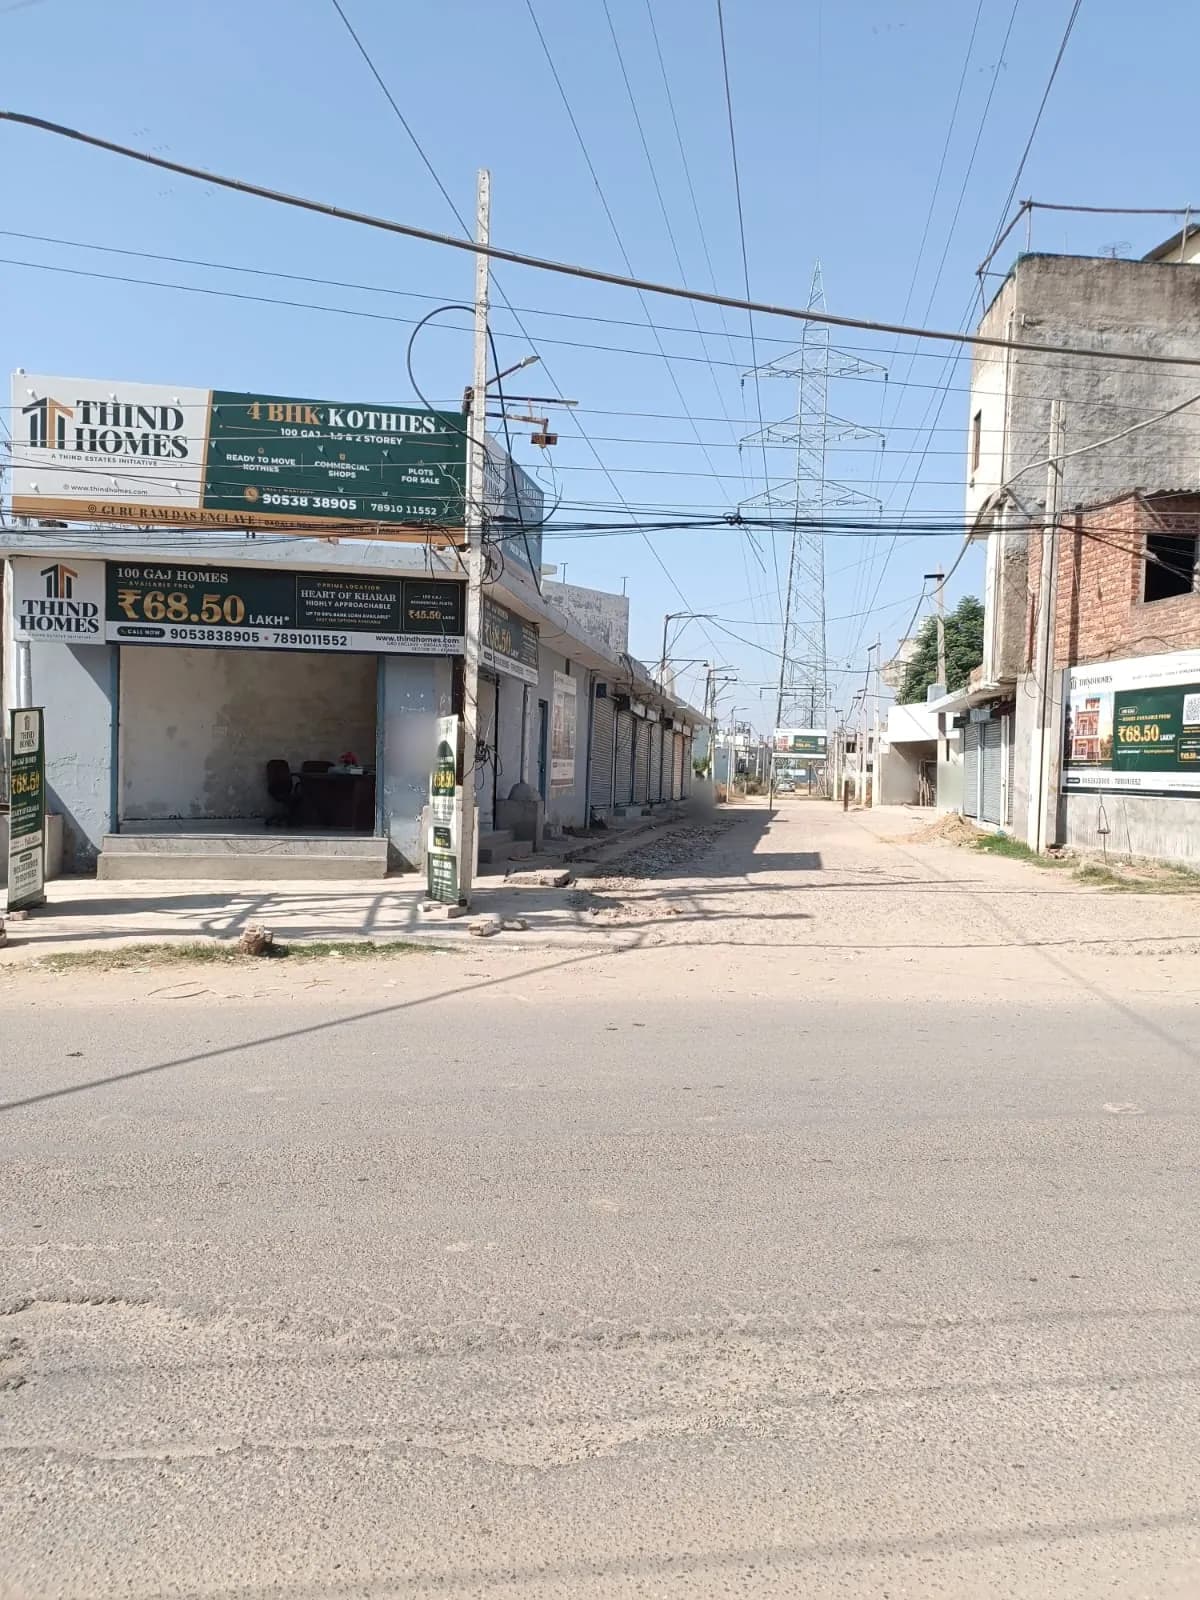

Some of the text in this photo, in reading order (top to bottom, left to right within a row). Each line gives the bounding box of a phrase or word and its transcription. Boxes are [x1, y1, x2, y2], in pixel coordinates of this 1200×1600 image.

[76, 399, 184, 431] THIND
[246, 401, 436, 434] 4 BHK KOTHIES
[74, 427, 188, 459] HOMES
[280, 428, 298, 437] 100
[300, 430, 321, 438] GAJ
[363, 435, 402, 445] STOREY
[84, 455, 117, 463] ESTATES
[118, 458, 157, 466] INITIATIVE
[226, 453, 255, 462] READY
[271, 457, 296, 466] MOVE
[314, 461, 370, 471] COMMERCIAL
[243, 463, 280, 473] KOTHIES
[328, 470, 357, 479] SHOPS
[408, 468, 434, 476] PLOTS
[401, 475, 440, 485] FOR SALE
[70, 484, 148, 495] www.thindhomes.com
[262, 493, 357, 510] 90538 38905
[370, 503, 437, 515] 78910 11552
[117, 568, 229, 583] 100 GAJ HOMES
[301, 590, 397, 602] HEART OF KHARAR
[22, 599, 98, 618] THIND
[117, 588, 245, 625] ₹68.50
[334, 601, 392, 610] APPROACHABLE
[20, 615, 99, 633] HOMES
[170, 628, 348, 646] 9053838905 7891011552
[375, 634, 460, 644] www.thindhomes.com
[1117, 724, 1159, 743] ₹68.50
